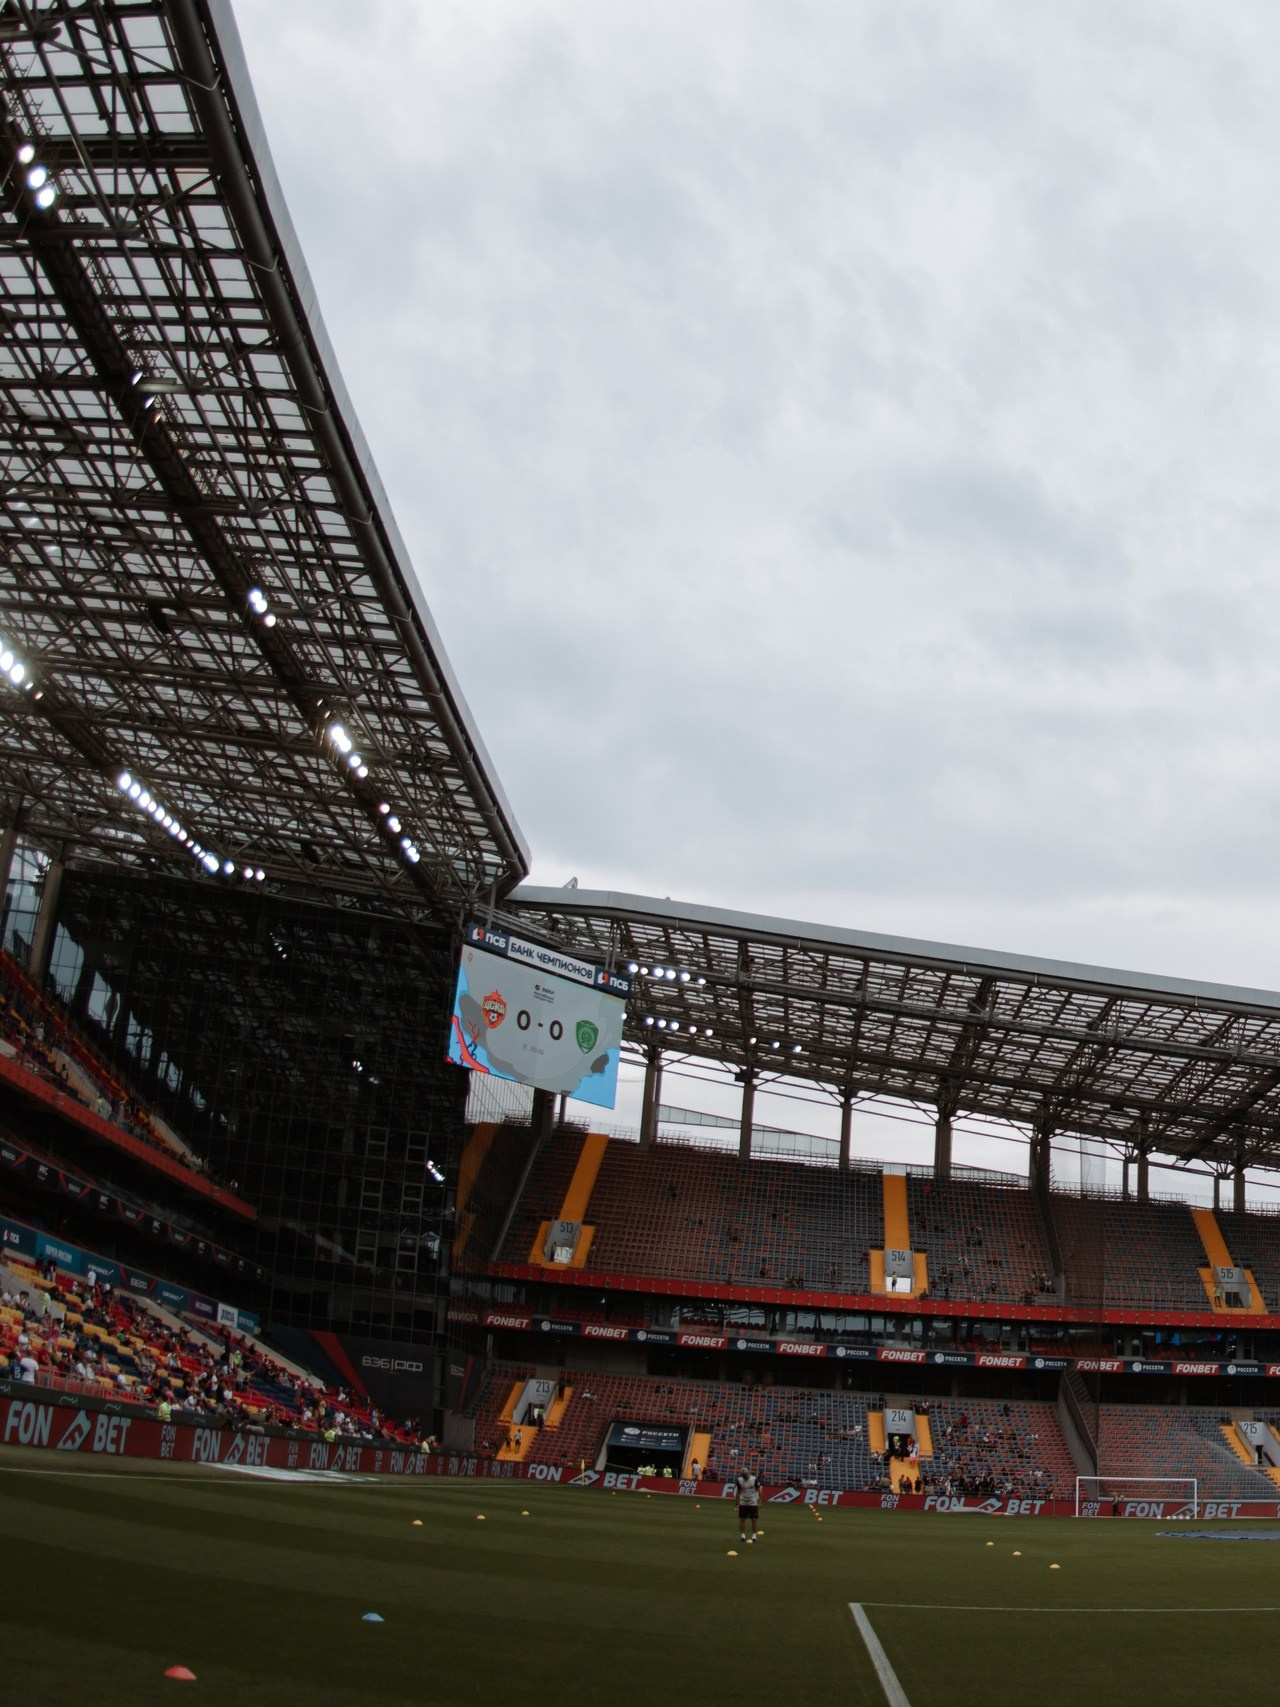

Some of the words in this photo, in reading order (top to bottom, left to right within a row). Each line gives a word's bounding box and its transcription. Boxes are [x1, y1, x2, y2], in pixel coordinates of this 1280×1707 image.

[486, 932, 506, 948] ПСБ
[510, 943, 534, 959] БАНК
[537, 952, 593, 979] ЧЕМПИОНОВ
[610, 977, 628, 991] ПСБ
[517, 1010, 531, 1031] 0
[550, 1020, 563, 1040] 0
[560, 1222, 573, 1233] 513
[892, 1250, 906, 1262] 514
[1220, 1268, 1234, 1279] 515
[487, 1315, 529, 1328] FONBET
[585, 1326, 628, 1338] FONBET
[681, 1335, 724, 1347] FONBET
[780, 1343, 823, 1354] FONBET
[881, 1351, 925, 1361] FONBET
[979, 1356, 1023, 1366] FONBET
[1077, 1360, 1120, 1371] FONBET
[1176, 1364, 1218, 1373] FONBET
[536, 1381, 550, 1393] 213
[891, 1410, 906, 1422] 214
[4, 1400, 54, 1446] FON
[93, 1413, 131, 1454] BET
[162, 1424, 176, 1440] FON
[1244, 1422, 1257, 1434] 215
[160, 1442, 174, 1457] BET
[192, 1428, 221, 1461] FON
[246, 1435, 271, 1465] BET
[309, 1442, 329, 1469] FON
[345, 1446, 362, 1471] BET
[527, 1463, 563, 1482] FON
[603, 1472, 642, 1489] BET
[804, 1489, 843, 1505] BET
[881, 1501, 899, 1509] BET
[924, 1495, 965, 1512] FON
[1006, 1499, 1045, 1515] BET
[1124, 1502, 1164, 1517] FON
[1204, 1503, 1242, 1518] BET
